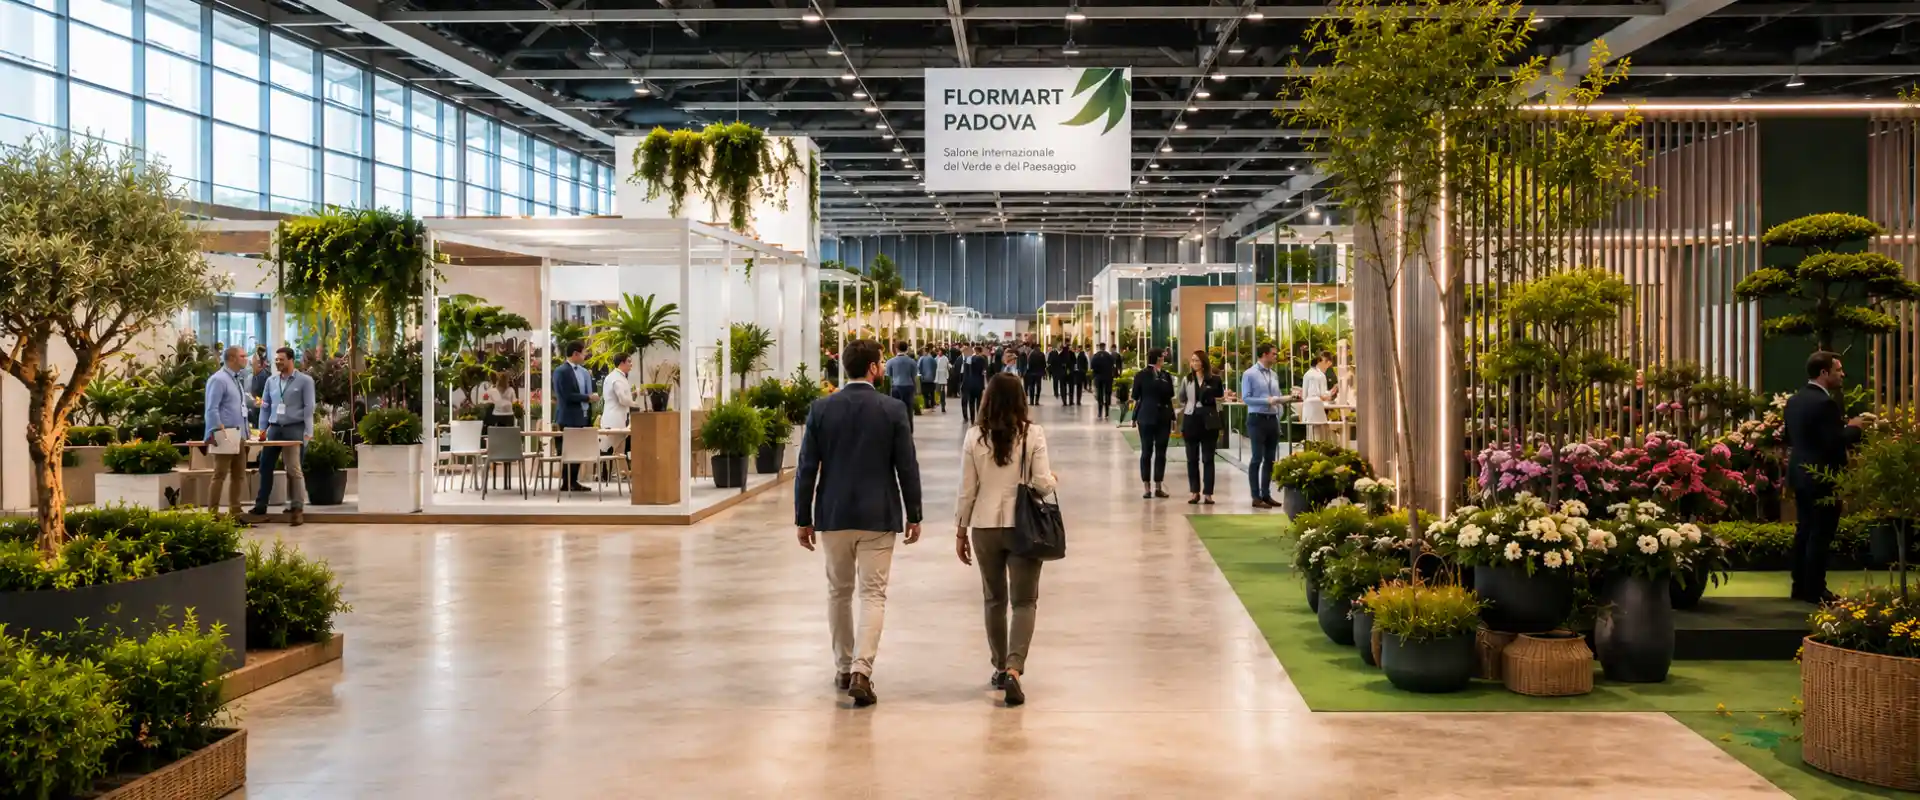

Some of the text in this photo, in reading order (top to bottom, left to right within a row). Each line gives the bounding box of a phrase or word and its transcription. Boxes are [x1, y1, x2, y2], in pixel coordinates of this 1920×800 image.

[944, 89, 1063, 105] FLORMART
[944, 114, 1036, 131] PADOVA
[944, 147, 1055, 158] Salone Internazionale
[944, 161, 959, 171] del
[962, 162, 992, 171] Verde
[1004, 161, 1019, 171] del
[1023, 161, 1076, 173] Paesaggio
